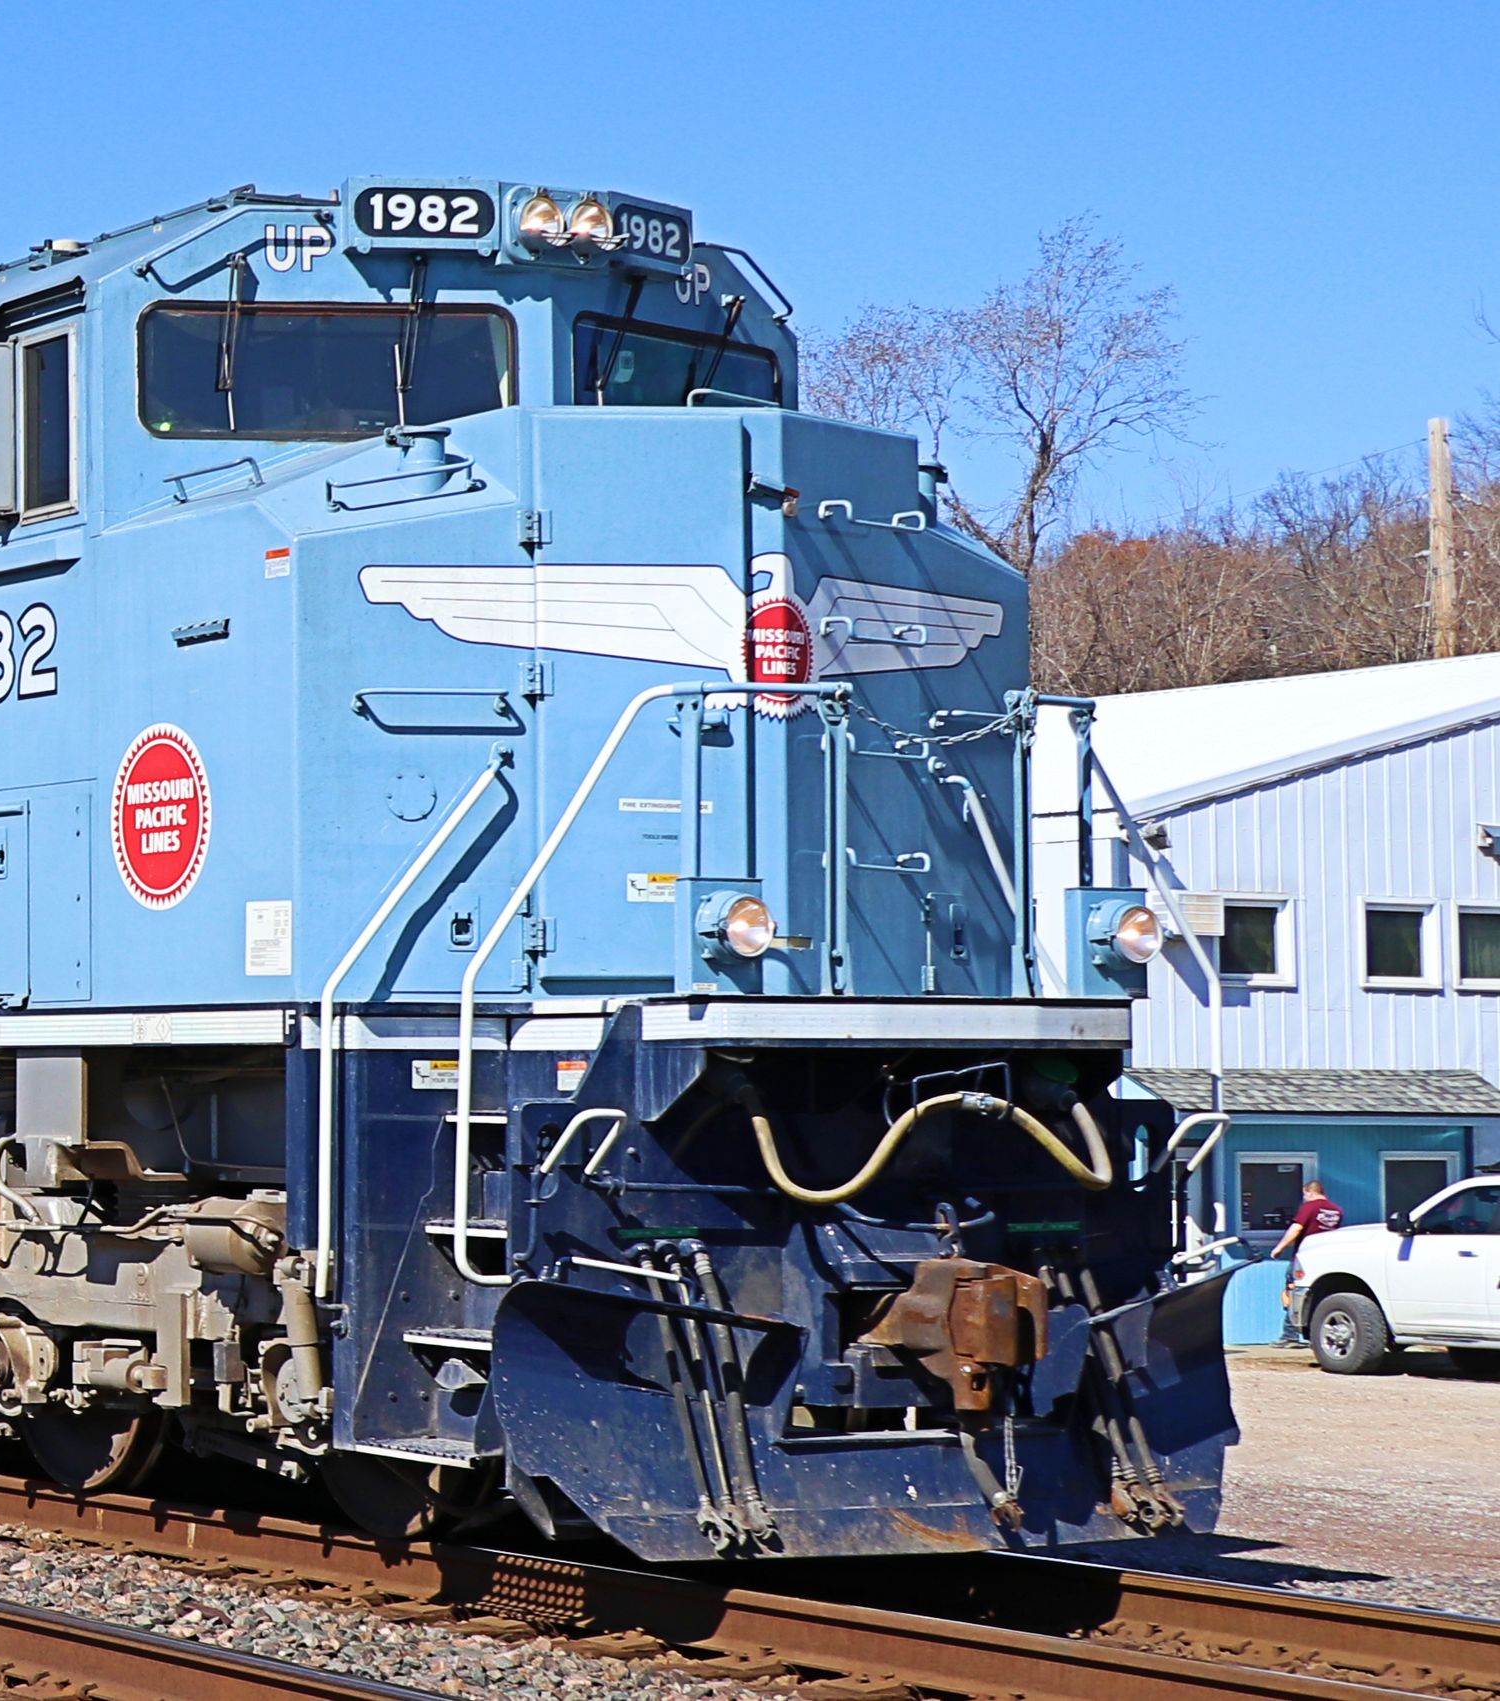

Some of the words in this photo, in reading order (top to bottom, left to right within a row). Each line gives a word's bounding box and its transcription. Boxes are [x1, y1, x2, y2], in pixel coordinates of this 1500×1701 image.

[369, 193, 479, 234] 1982
[264, 224, 334, 273] UP
[620, 212, 682, 259] 1982
[674, 262, 711, 306] UP
[746, 628, 805, 645] MISSOURI
[755, 644, 801, 660] PACIFIC
[762, 660, 797, 676] LINES
[127, 777, 195, 806] MISSOURI
[135, 803, 188, 830] PACIFIC
[141, 829, 182, 855] LINES
[285, 1009, 296, 1035] F
